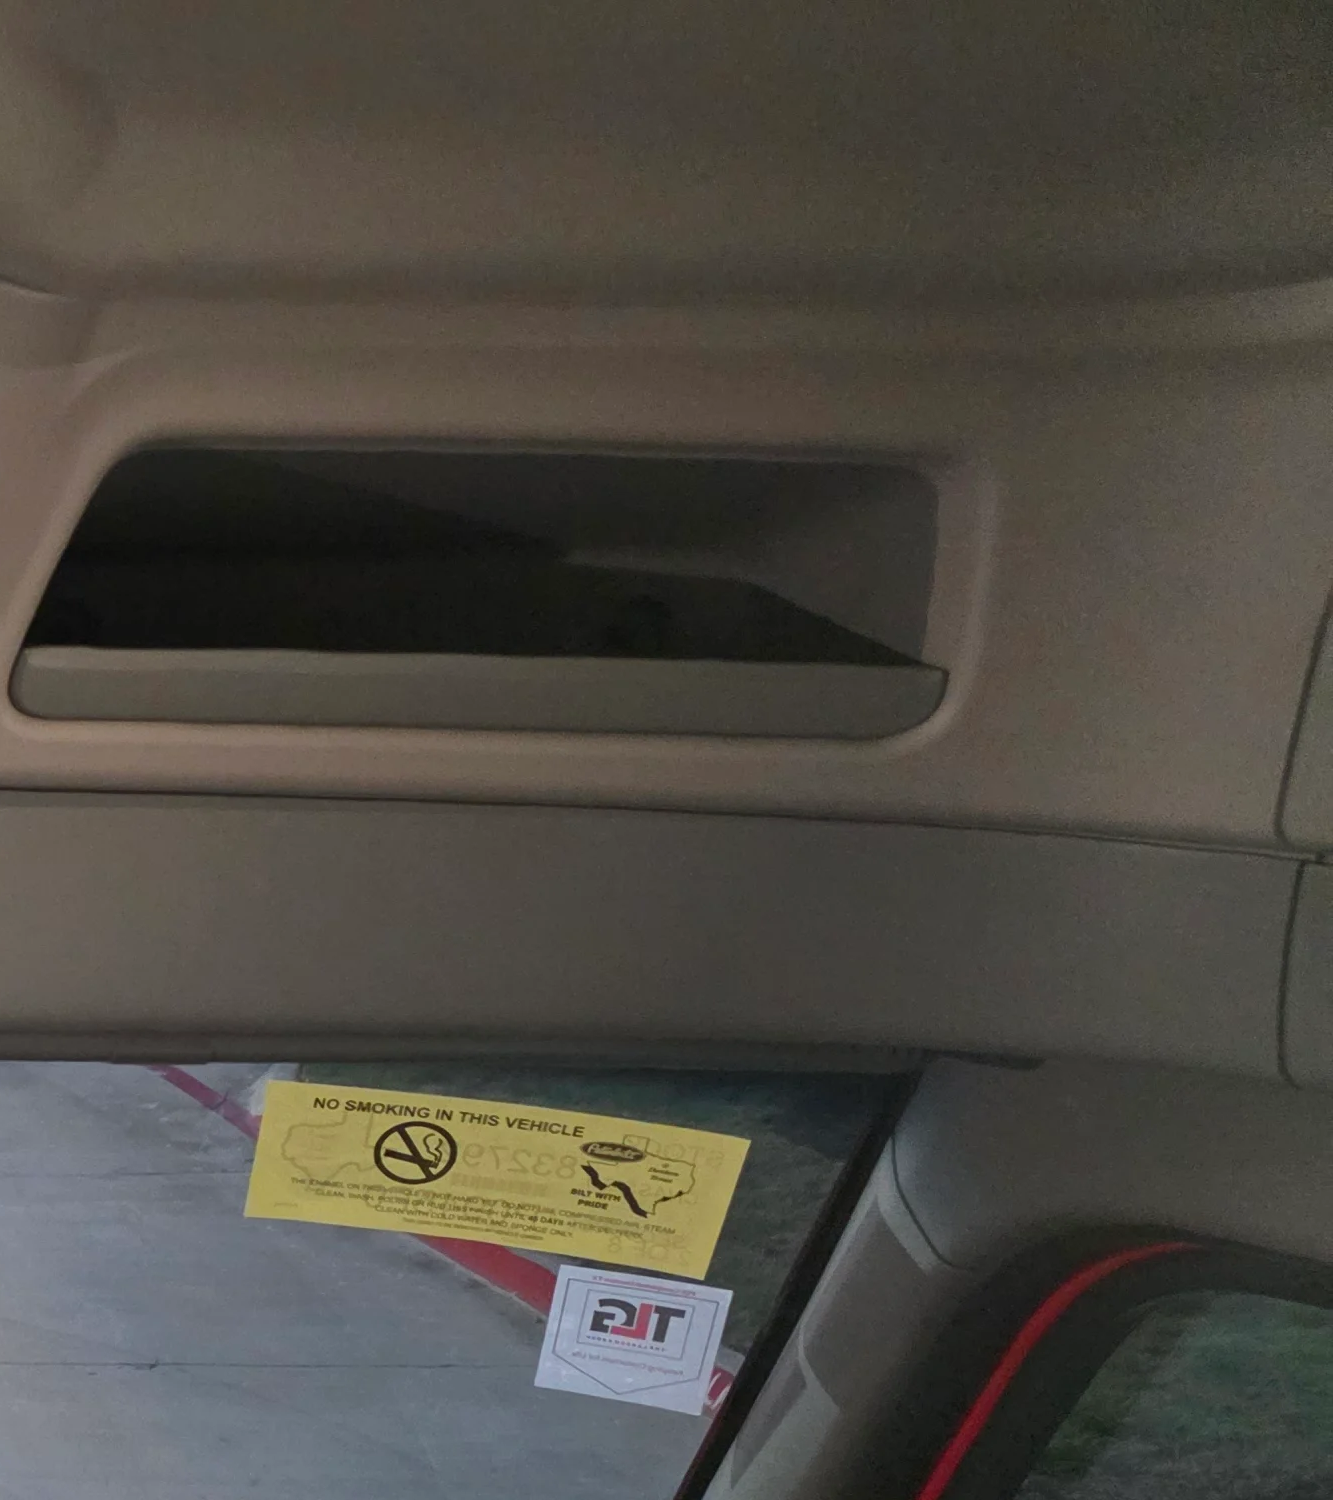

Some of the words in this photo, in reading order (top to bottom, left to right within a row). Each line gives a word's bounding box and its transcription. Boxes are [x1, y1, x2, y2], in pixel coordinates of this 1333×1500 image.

[313, 1096, 340, 1110] NO
[344, 1099, 431, 1119] SMOKING
[435, 1108, 453, 1122] IN
[459, 1111, 500, 1127] THIS
[505, 1116, 586, 1138] VEHICLE
[571, 1187, 594, 1199] BILT
[595, 1191, 622, 1202] WITH
[577, 1199, 609, 1210] PRIDE
[539, 1216, 564, 1226] DAYS
[511, 1222, 549, 1234] SPONGE
[643, 1223, 676, 1234] STEAM
